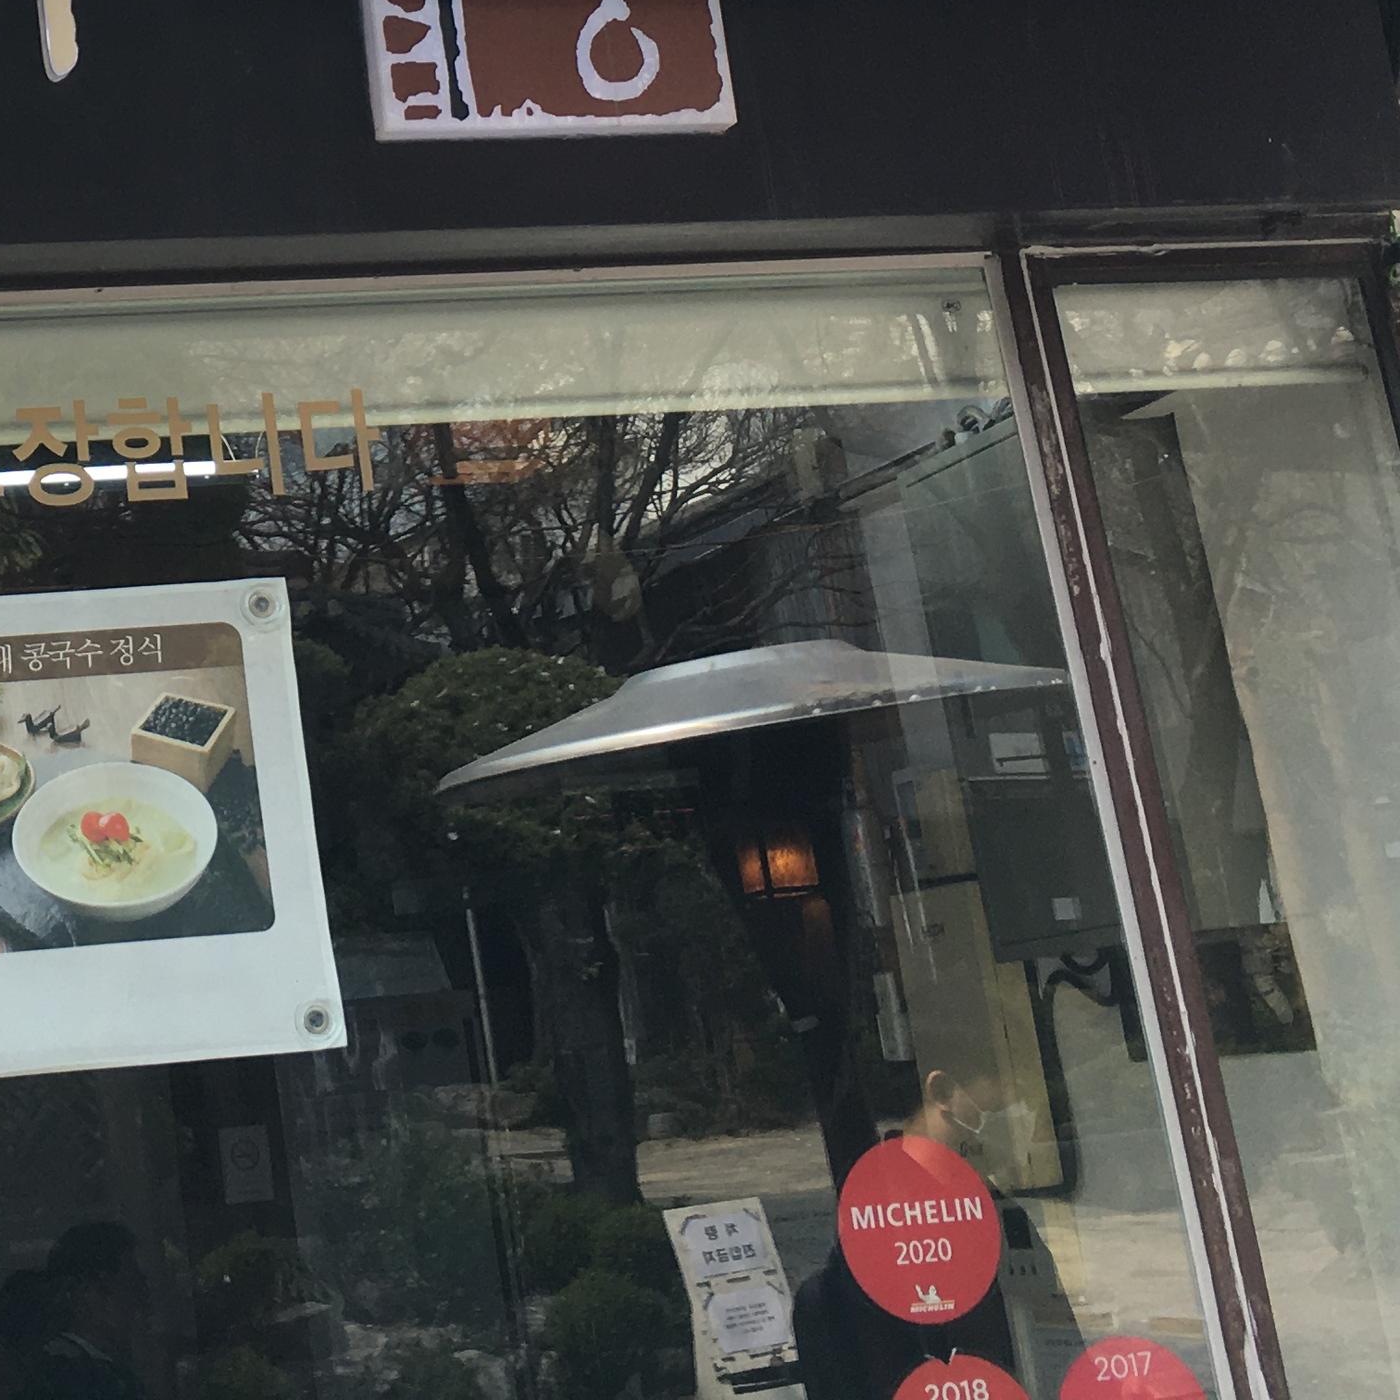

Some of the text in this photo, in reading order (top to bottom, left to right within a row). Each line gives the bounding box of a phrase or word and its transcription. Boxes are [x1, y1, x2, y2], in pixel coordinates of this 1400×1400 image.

[20, 638, 104, 672] 콩국수
[110, 633, 163, 666] 정식
[851, 1196, 984, 1230] MICHELIN
[894, 1237, 953, 1265] 2020
[1094, 1351, 1151, 1382] 2017
[924, 1379, 990, 1400] 2018
